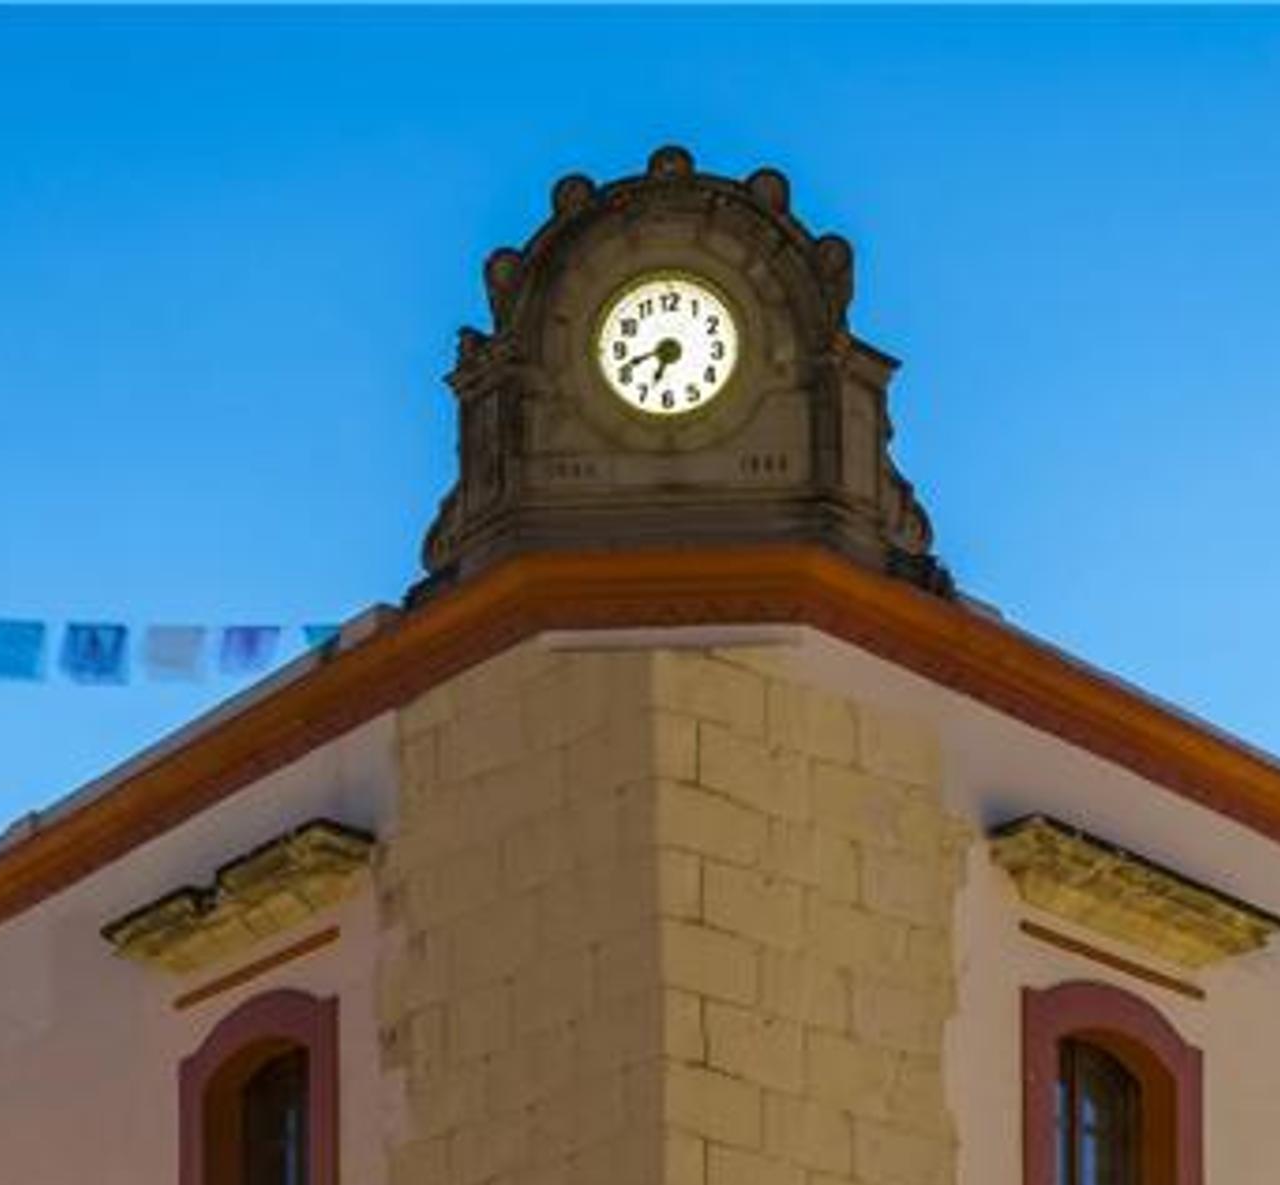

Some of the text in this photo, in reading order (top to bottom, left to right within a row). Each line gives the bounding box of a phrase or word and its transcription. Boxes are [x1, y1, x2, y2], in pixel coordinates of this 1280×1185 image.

[639, 299, 653, 319] 11
[659, 292, 681, 312] 12
[691, 299, 699, 319] 1
[621, 318, 637, 337] 10
[706, 316, 719, 335] 2
[612, 340, 627, 360] 9
[710, 340, 725, 360] 3
[703, 365, 717, 384] 4
[637, 384, 649, 403] 7
[660, 389, 675, 409] 6
[685, 384, 701, 403] 5
